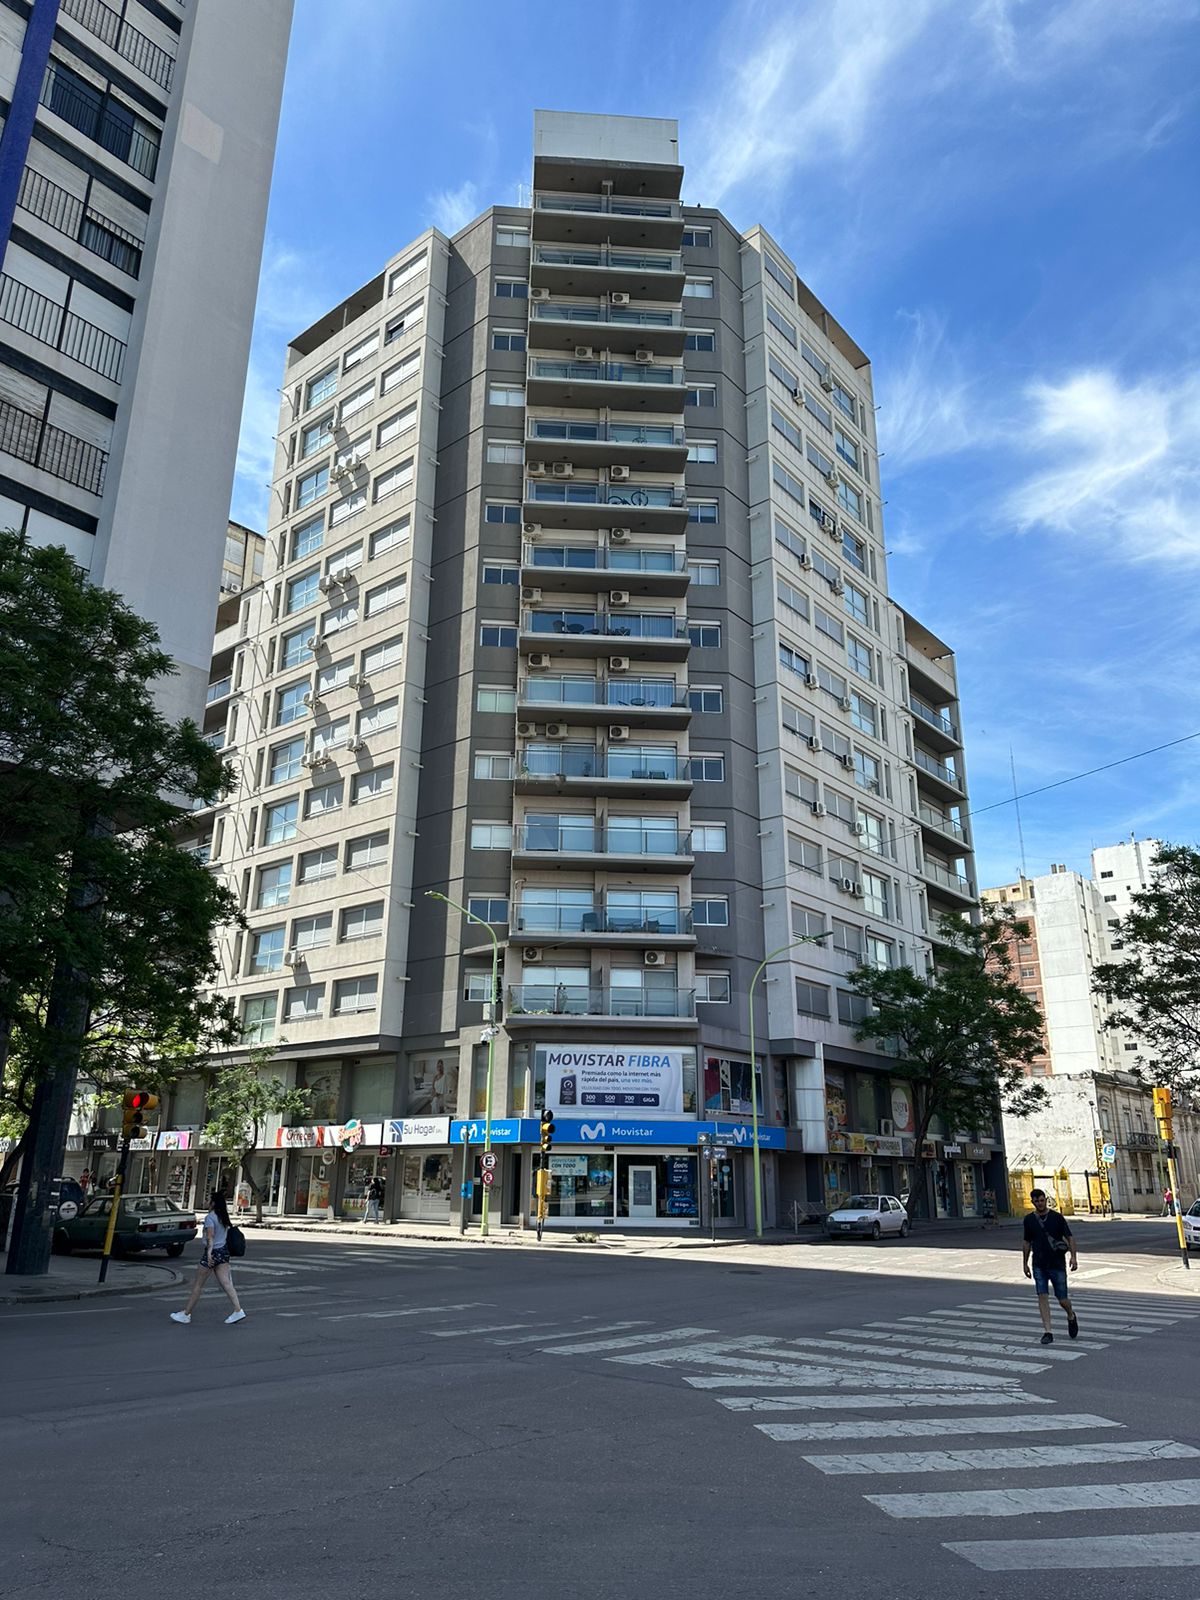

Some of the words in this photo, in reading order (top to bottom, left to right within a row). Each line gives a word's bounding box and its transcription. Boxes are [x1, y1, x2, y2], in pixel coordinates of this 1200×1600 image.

[548, 1053, 625, 1067] MOVISTAR
[628, 1055, 671, 1068] FIBRA
[404, 1124, 413, 1135] Su
[414, 1124, 436, 1136] Hogar
[481, 1129, 512, 1137] Mvistar
[612, 1127, 654, 1137] Movistar
